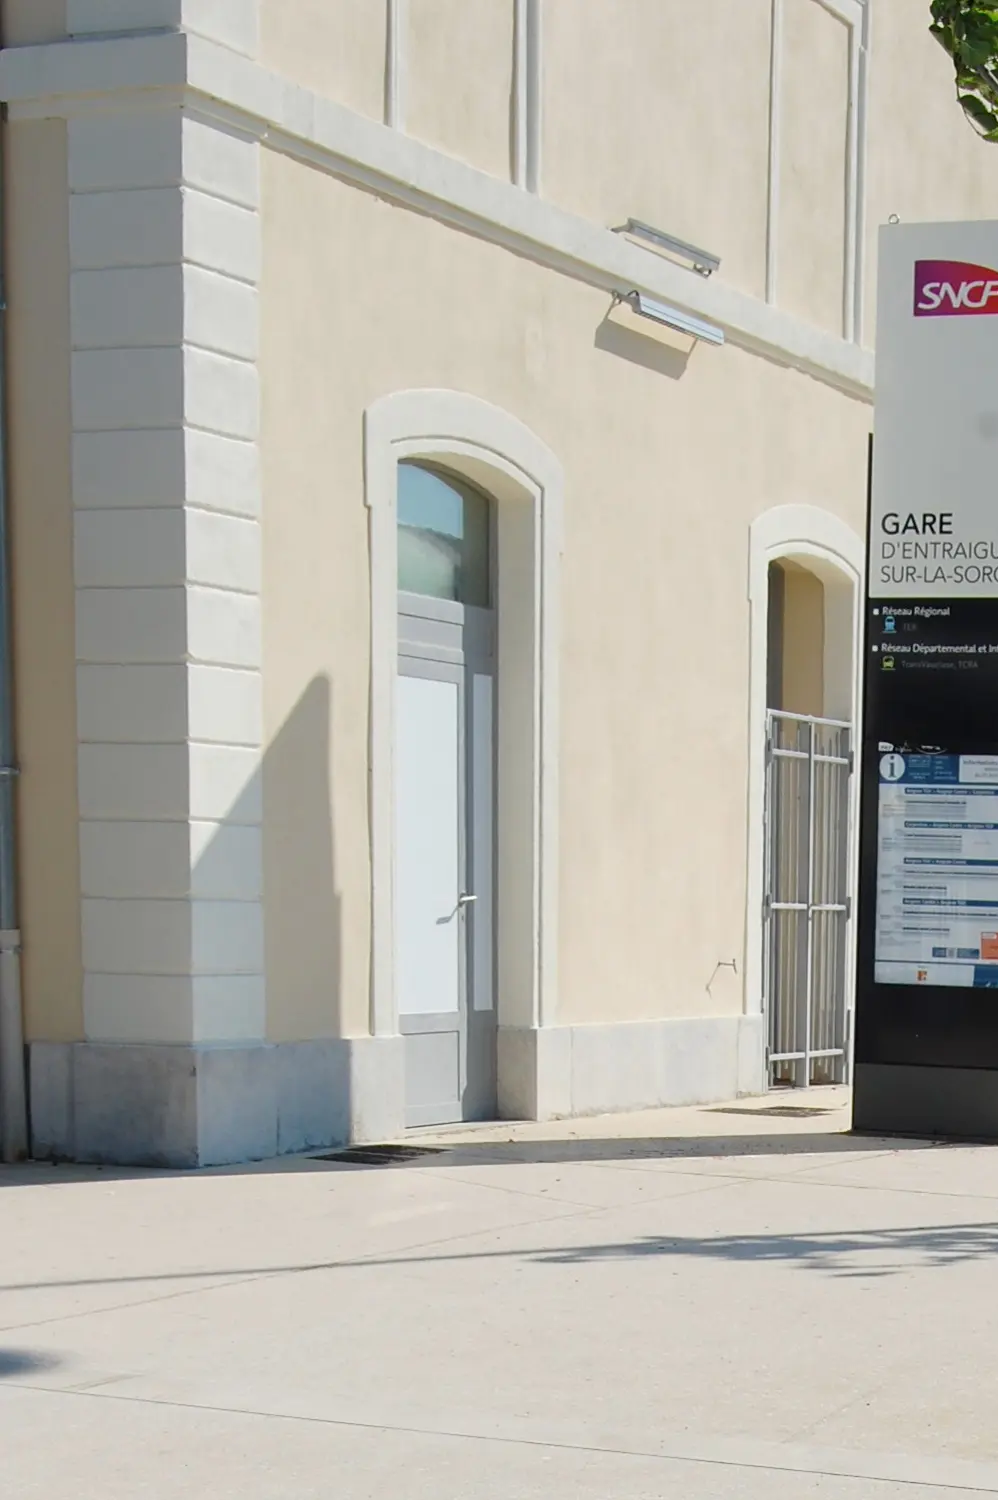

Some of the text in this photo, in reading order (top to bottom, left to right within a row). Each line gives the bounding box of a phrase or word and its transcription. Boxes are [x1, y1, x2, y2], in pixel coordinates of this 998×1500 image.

[881, 512, 953, 536] GARE
[882, 606, 951, 618] Réseau Régional
[881, 643, 911, 653] Réseau
[913, 643, 976, 655] Départemental
[978, 644, 987, 653] et
